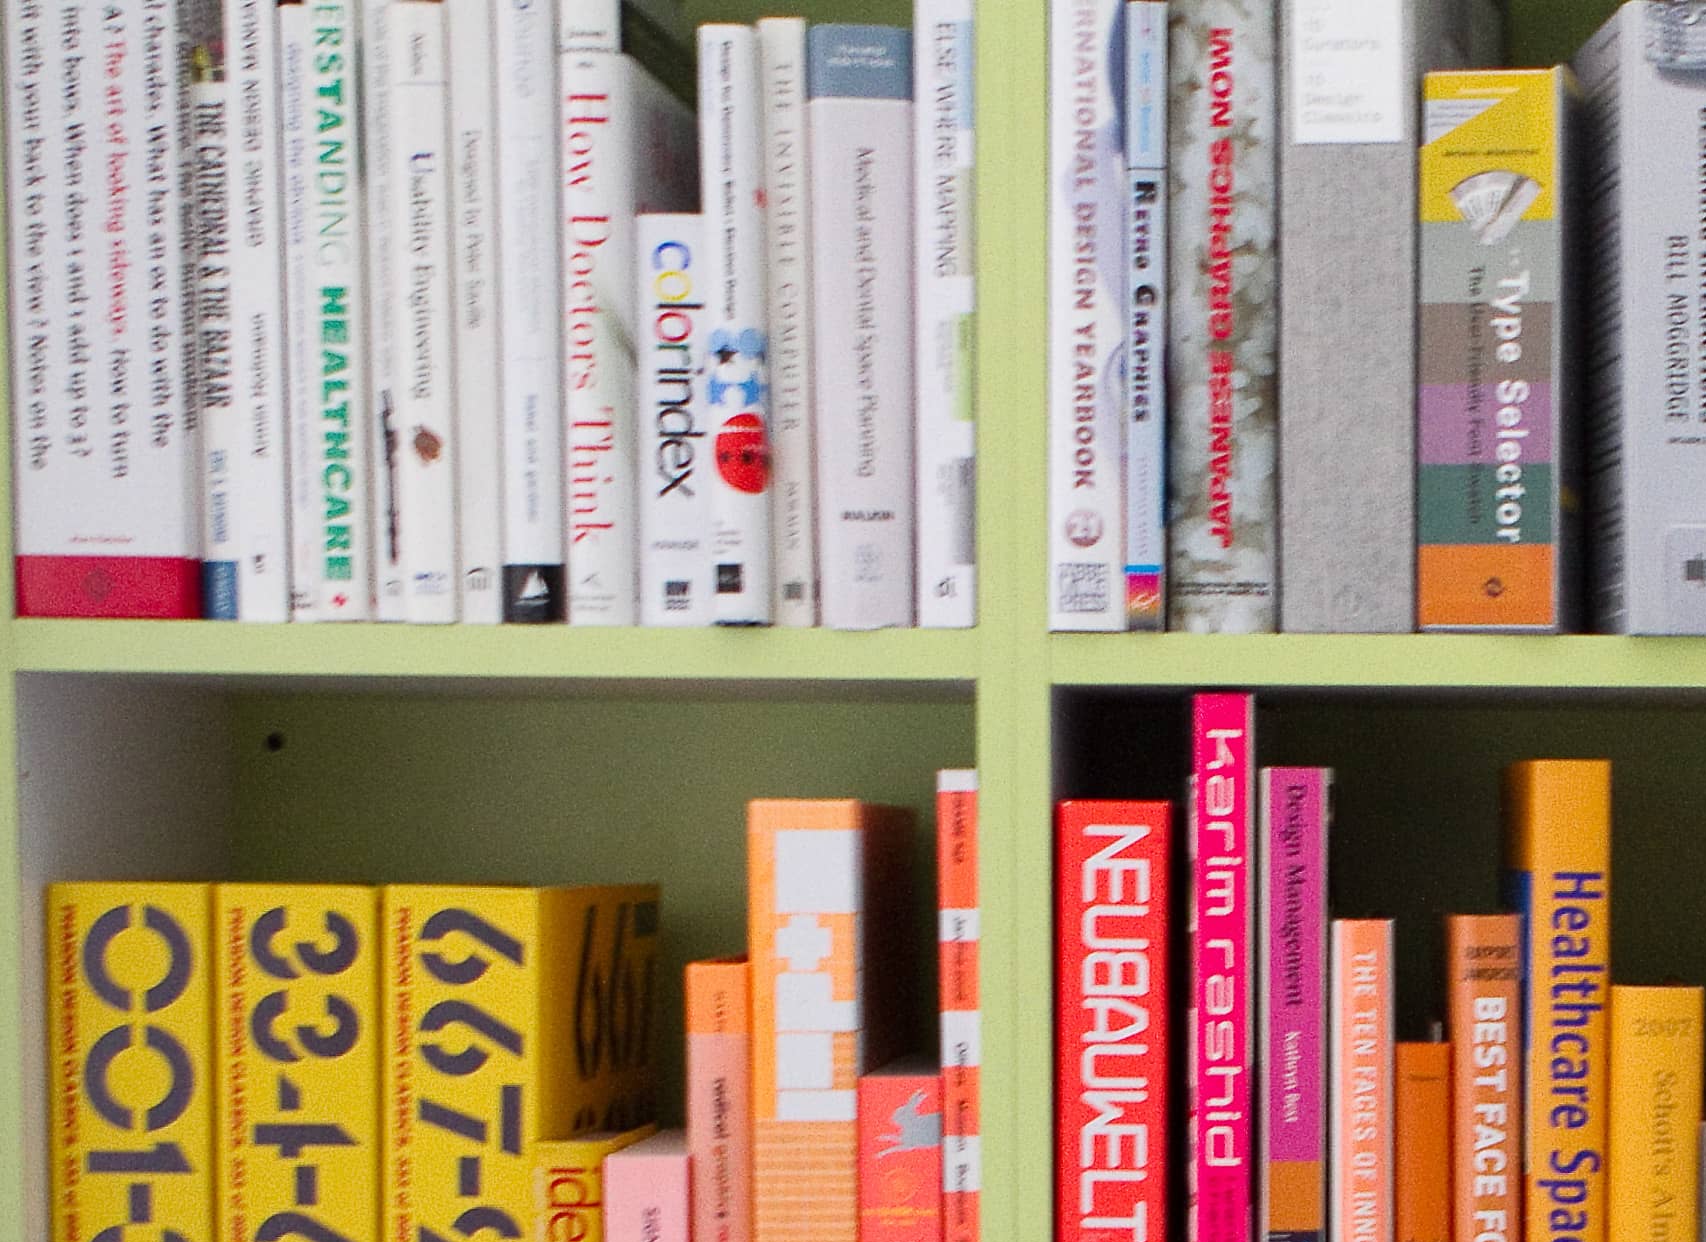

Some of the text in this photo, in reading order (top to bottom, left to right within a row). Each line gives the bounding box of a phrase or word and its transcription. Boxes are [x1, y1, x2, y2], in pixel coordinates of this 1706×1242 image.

[105, 41, 128, 77] The
[107, 123, 128, 144] of
[566, 92, 615, 545] How Doctors Think
[653, 241, 705, 497] colorindex
[1208, 28, 1233, 549] JAPANESE GRAPHICS NOW!
[1666, 236, 1690, 424] BILL MOGGRIDGE
[321, 286, 353, 581] HEALTHCARE
[1492, 270, 1529, 544] Type Selector
[1204, 727, 1241, 1167] karim rashid
[1283, 782, 1308, 1007] Design Management
[1353, 950, 1377, 998] THE
[1353, 1007, 1377, 1055] TEN
[1474, 998, 1507, 1093] BEST
[1549, 871, 1605, 1130] Healthcare
[1353, 1064, 1377, 1145] FACES
[1353, 1152, 1377, 1184] OF
[1476, 1103, 1505, 1198] FACE
